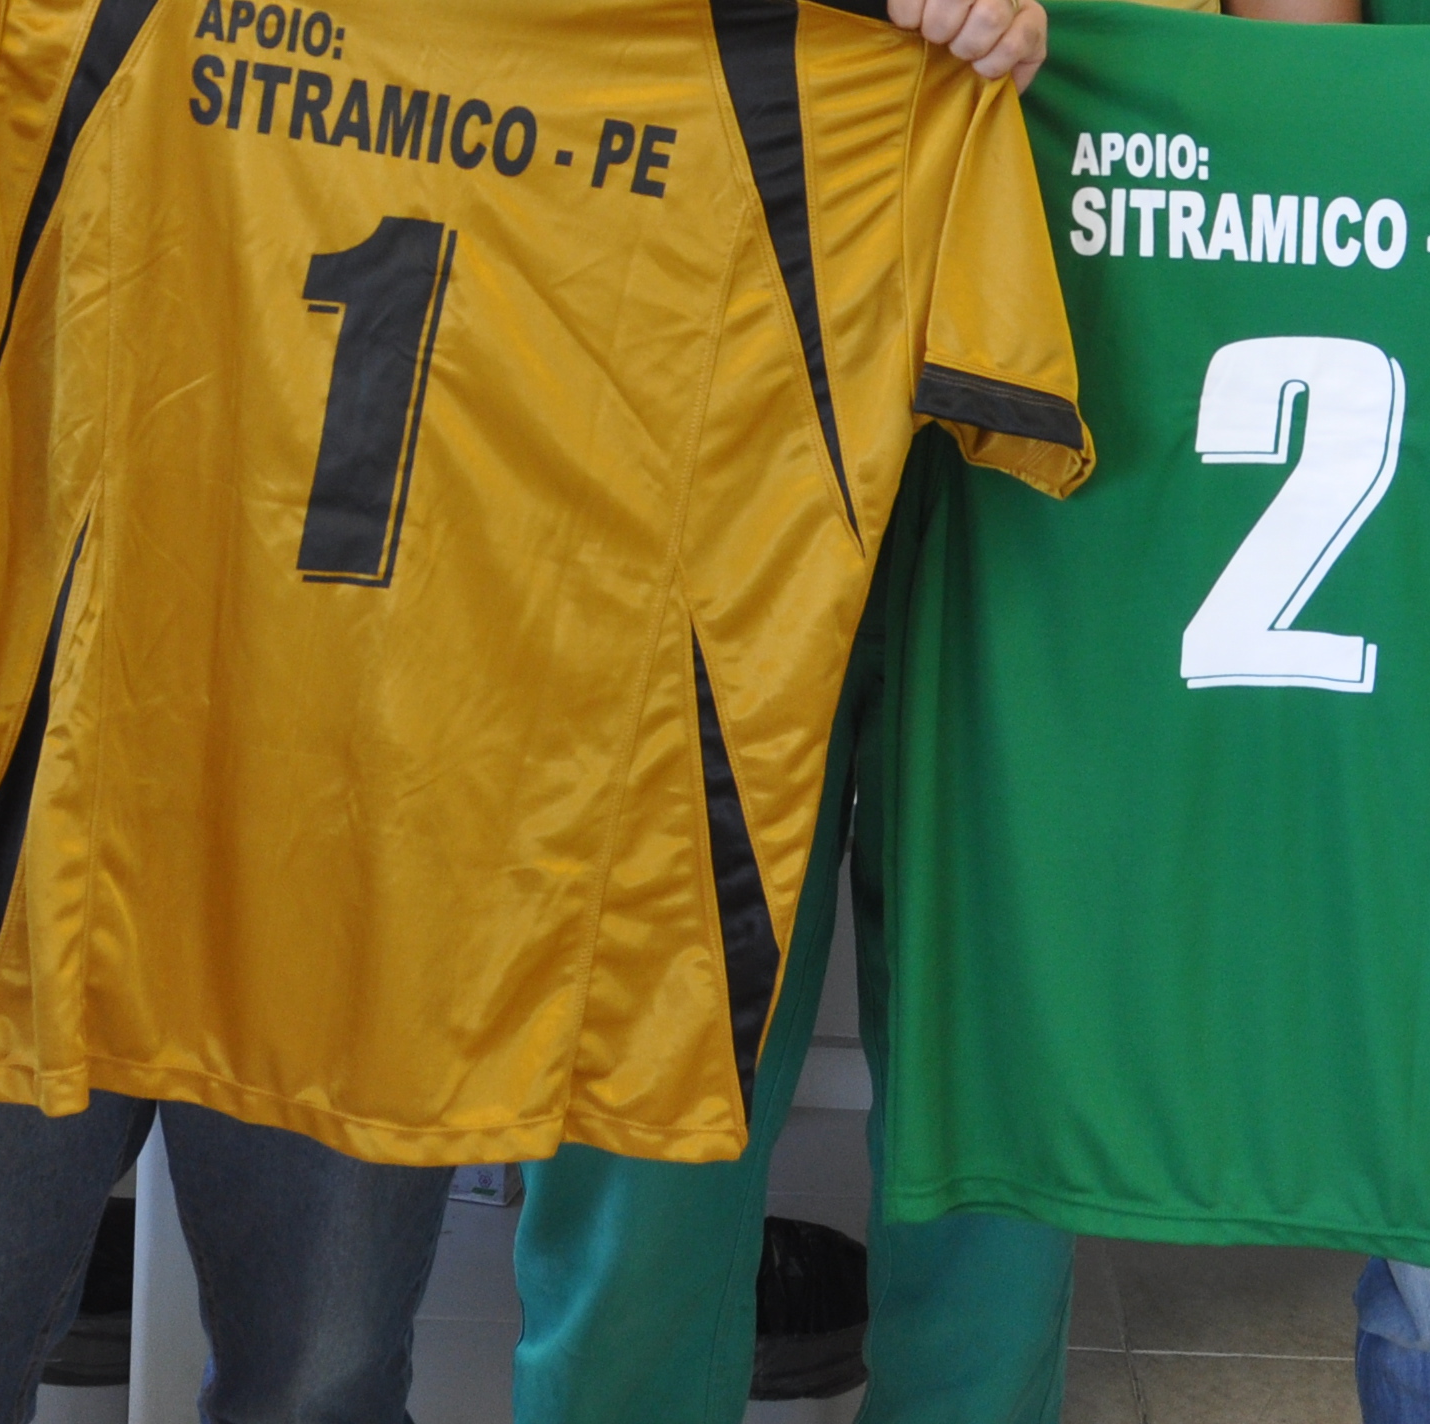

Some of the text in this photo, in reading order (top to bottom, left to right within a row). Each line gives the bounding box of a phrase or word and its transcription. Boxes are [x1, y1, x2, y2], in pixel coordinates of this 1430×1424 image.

[188, 54, 677, 199] SITRAMICO - PE
[1071, 132, 1209, 181] APOIO:
[1070, 187, 1408, 270] SITRAMICO
[295, 215, 458, 589] 1
[1179, 336, 1406, 694] 2
